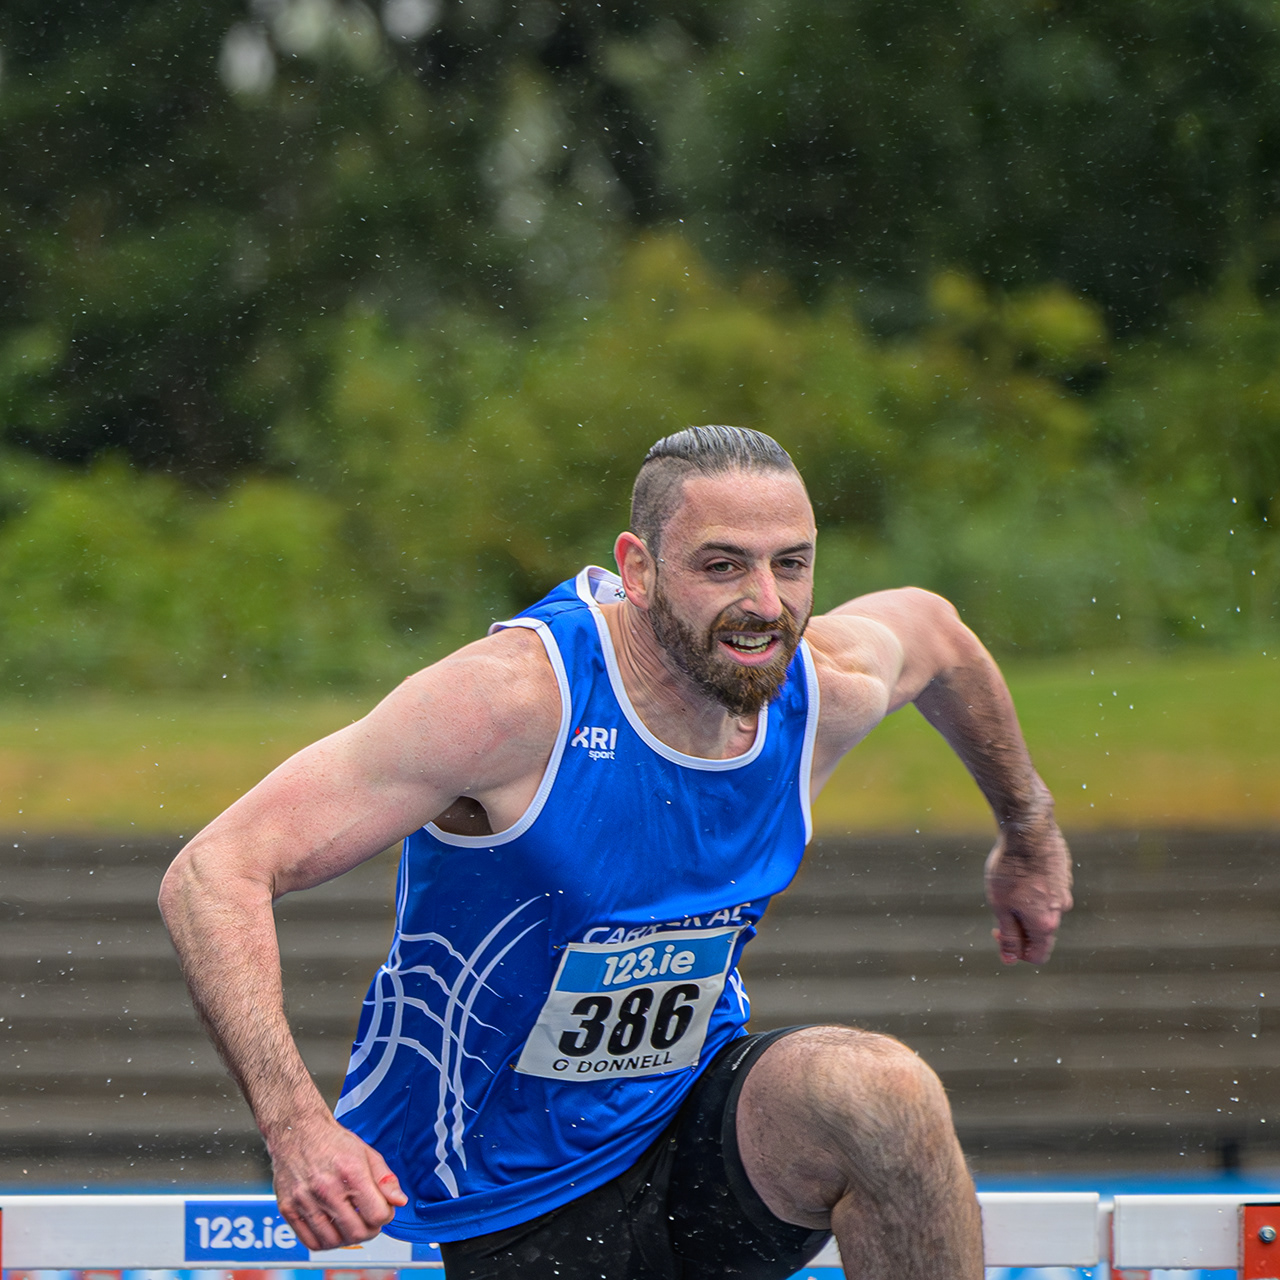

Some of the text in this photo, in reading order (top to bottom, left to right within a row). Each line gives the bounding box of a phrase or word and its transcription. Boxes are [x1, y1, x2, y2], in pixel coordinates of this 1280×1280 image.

[588, 749, 616, 761] sport
[602, 944, 696, 986] 123.ie
[558, 983, 700, 1057] 386
[552, 1051, 673, 1073] O DONNELL
[195, 1216, 297, 1249] 123.ie
